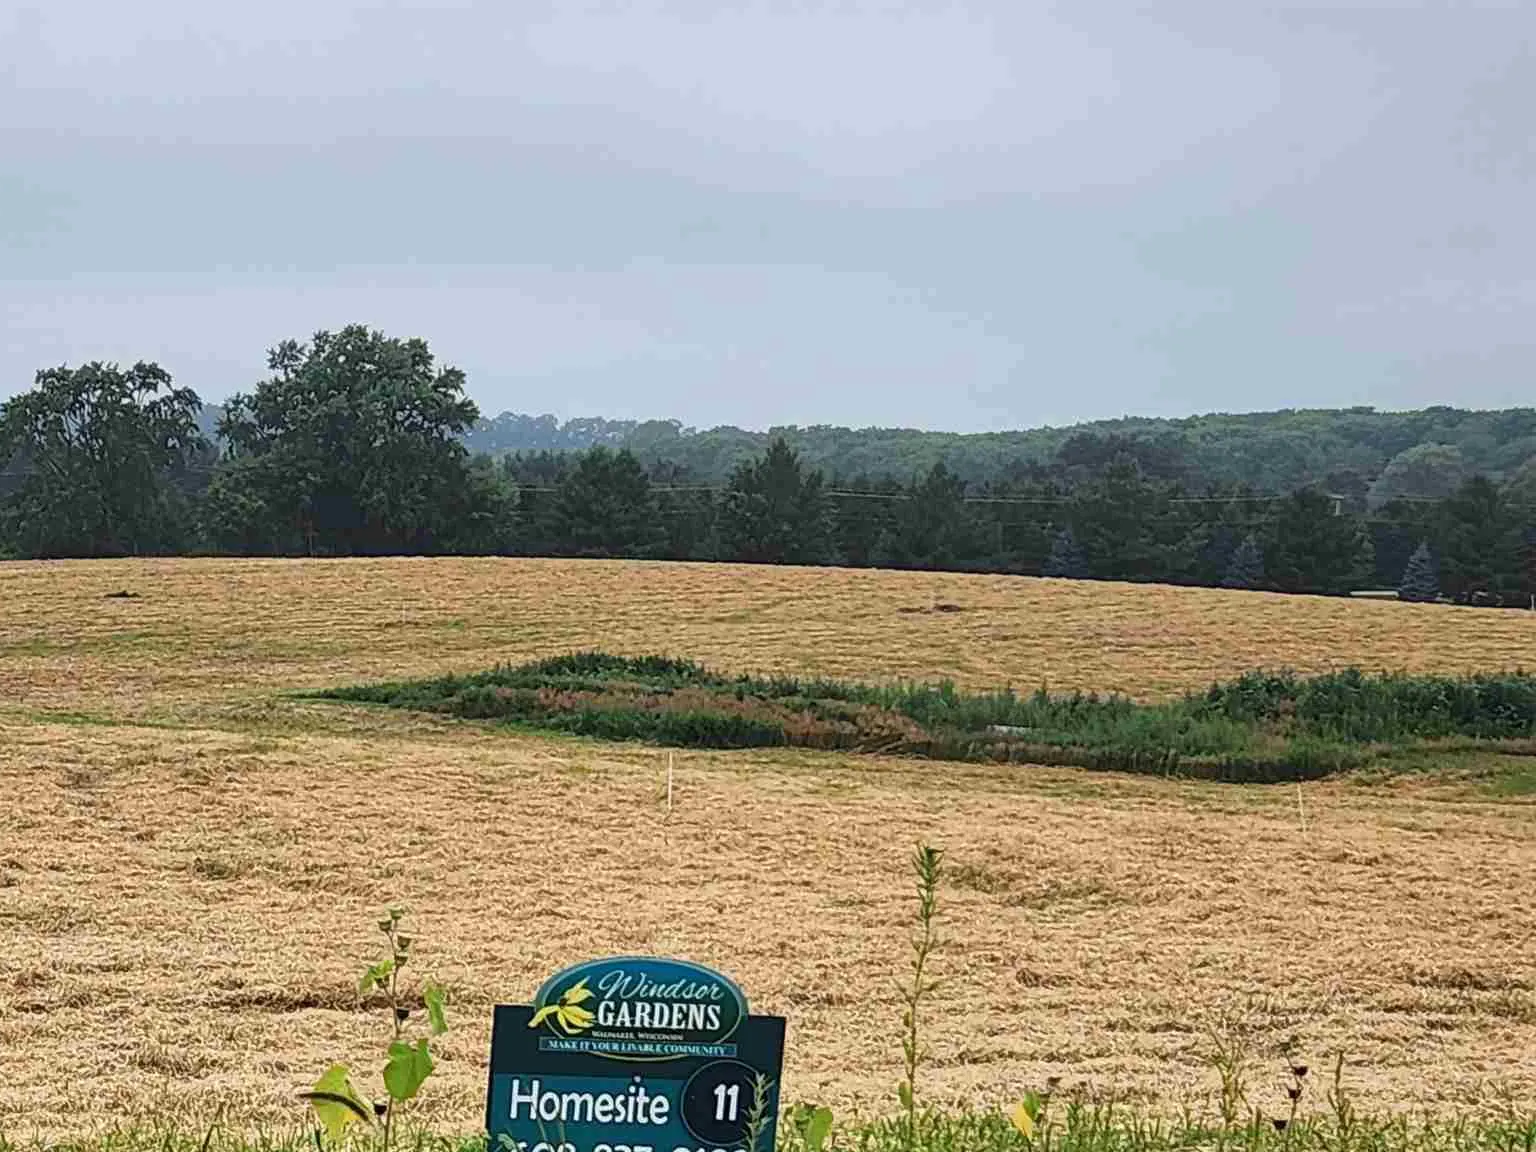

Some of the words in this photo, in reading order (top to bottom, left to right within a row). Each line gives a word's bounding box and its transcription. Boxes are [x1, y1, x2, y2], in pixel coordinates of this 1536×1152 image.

[598, 969, 725, 1001] Windsor
[597, 1001, 721, 1031] GARDENS
[548, 1039, 579, 1050] MAKE
[579, 1041, 591, 1051] IT
[591, 1041, 620, 1052] YOUR
[621, 1042, 664, 1053] LIVABLE
[664, 1043, 727, 1056] COMMUNITY
[510, 1075, 670, 1125] Homesite
[714, 1083, 739, 1122] 11
